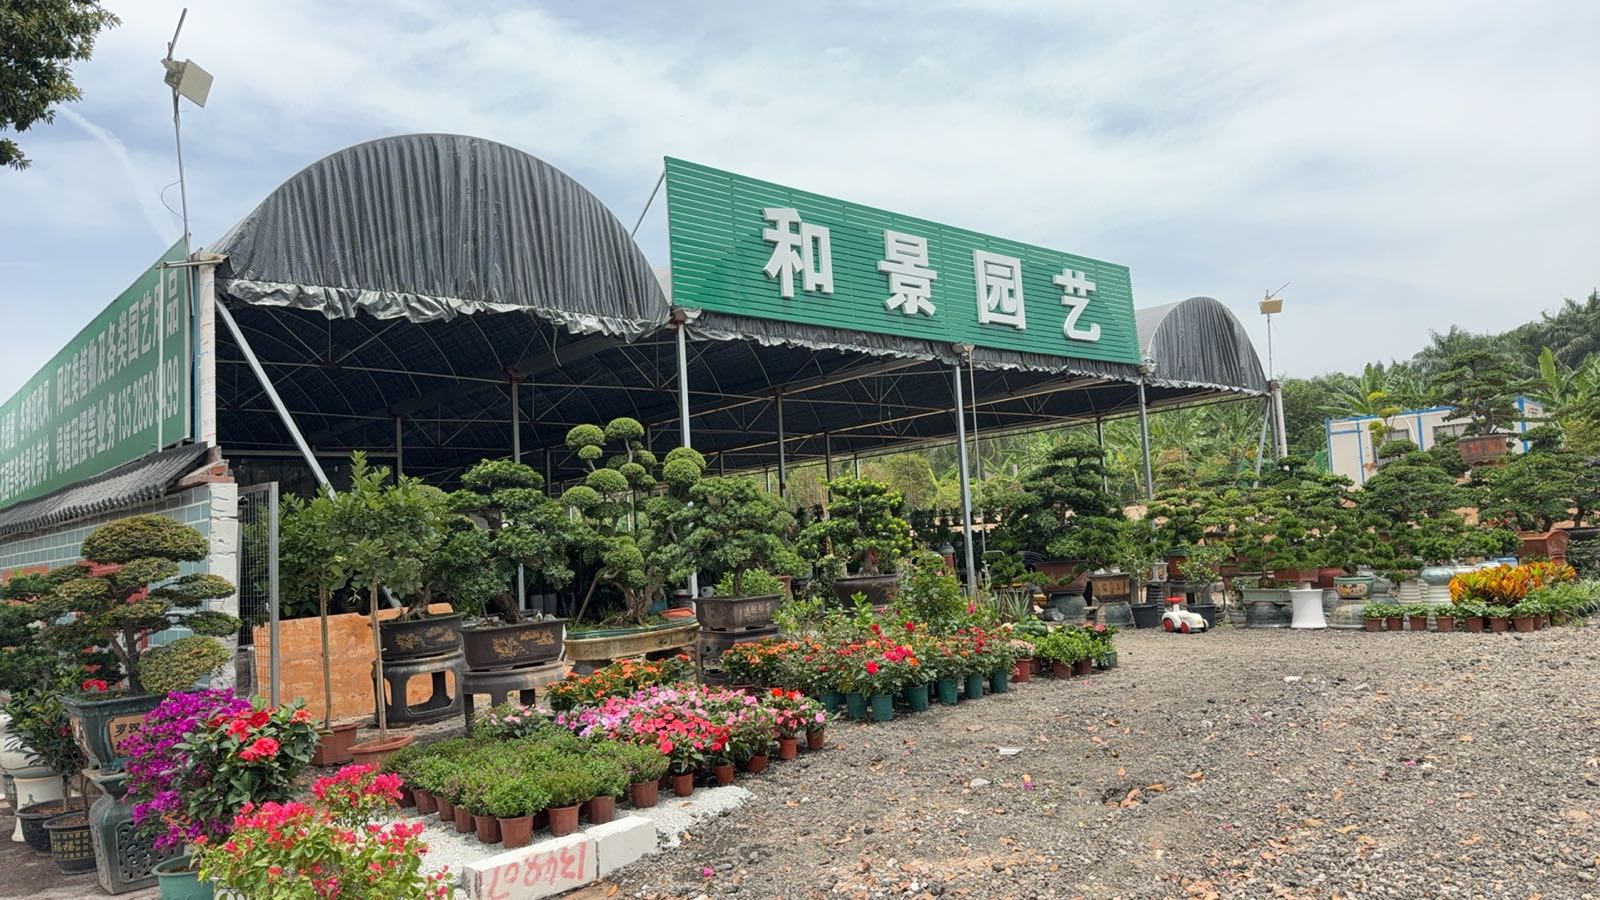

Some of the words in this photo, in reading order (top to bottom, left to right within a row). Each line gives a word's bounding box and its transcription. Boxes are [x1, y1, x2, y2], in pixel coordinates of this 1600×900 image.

[762, 207, 1101, 342] 和景园艺
[118, 385, 131, 441] 135
[132, 370, 154, 434] 2858
